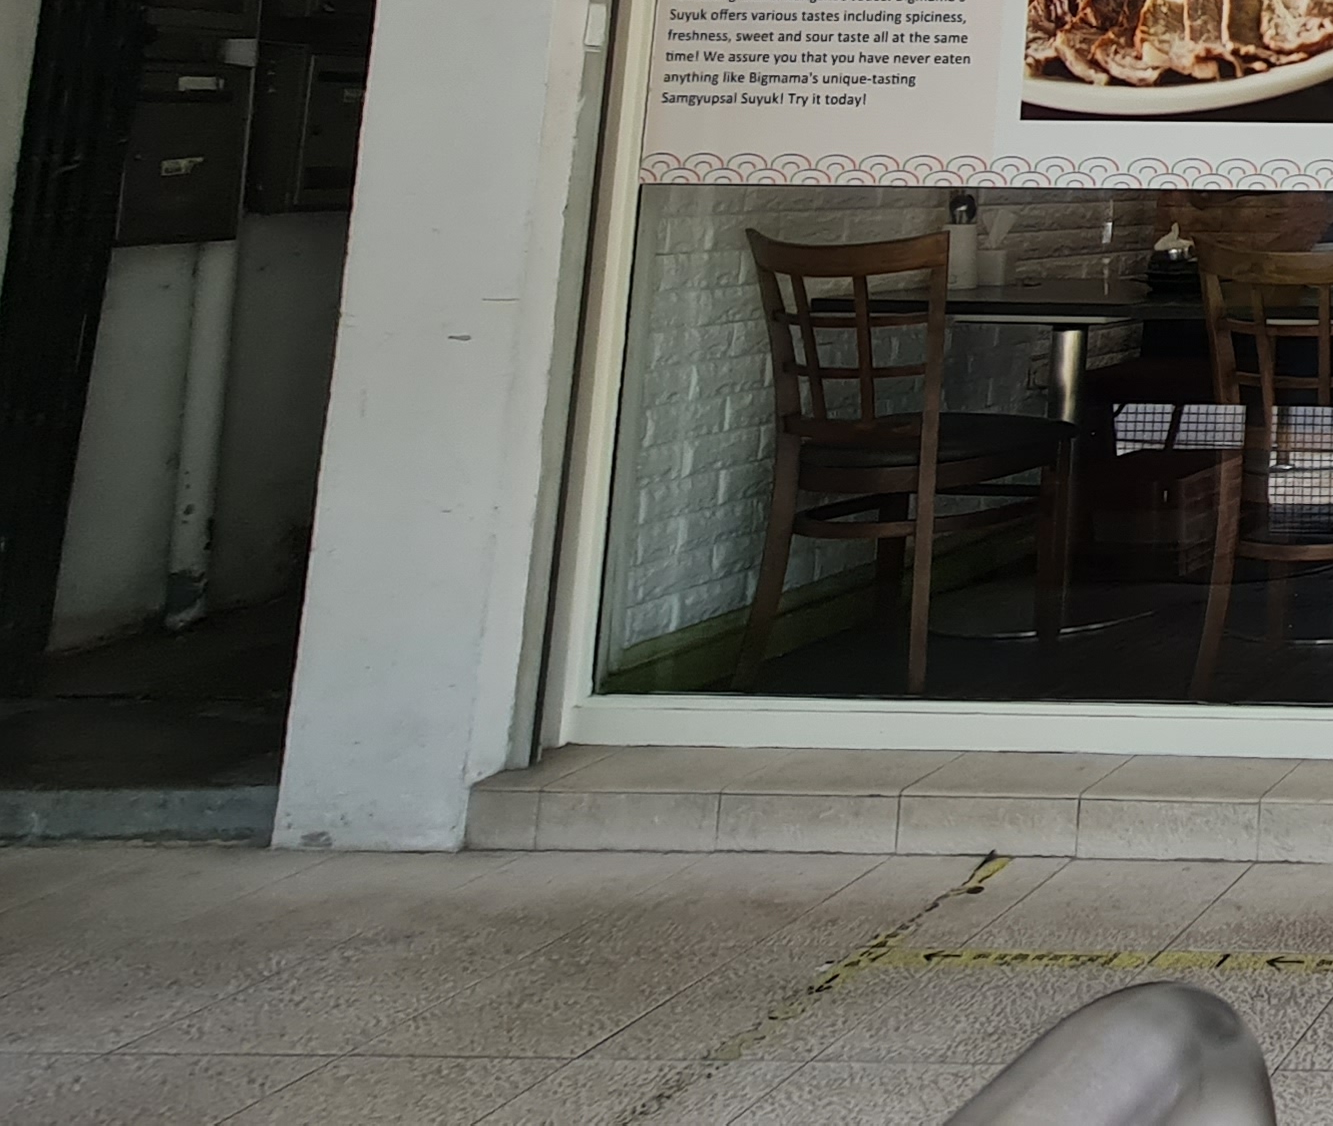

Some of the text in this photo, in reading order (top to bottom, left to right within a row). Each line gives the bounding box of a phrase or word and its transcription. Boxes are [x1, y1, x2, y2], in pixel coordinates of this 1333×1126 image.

[661, 92, 867, 108] Samgyupsal Suyuk! Try it today!
